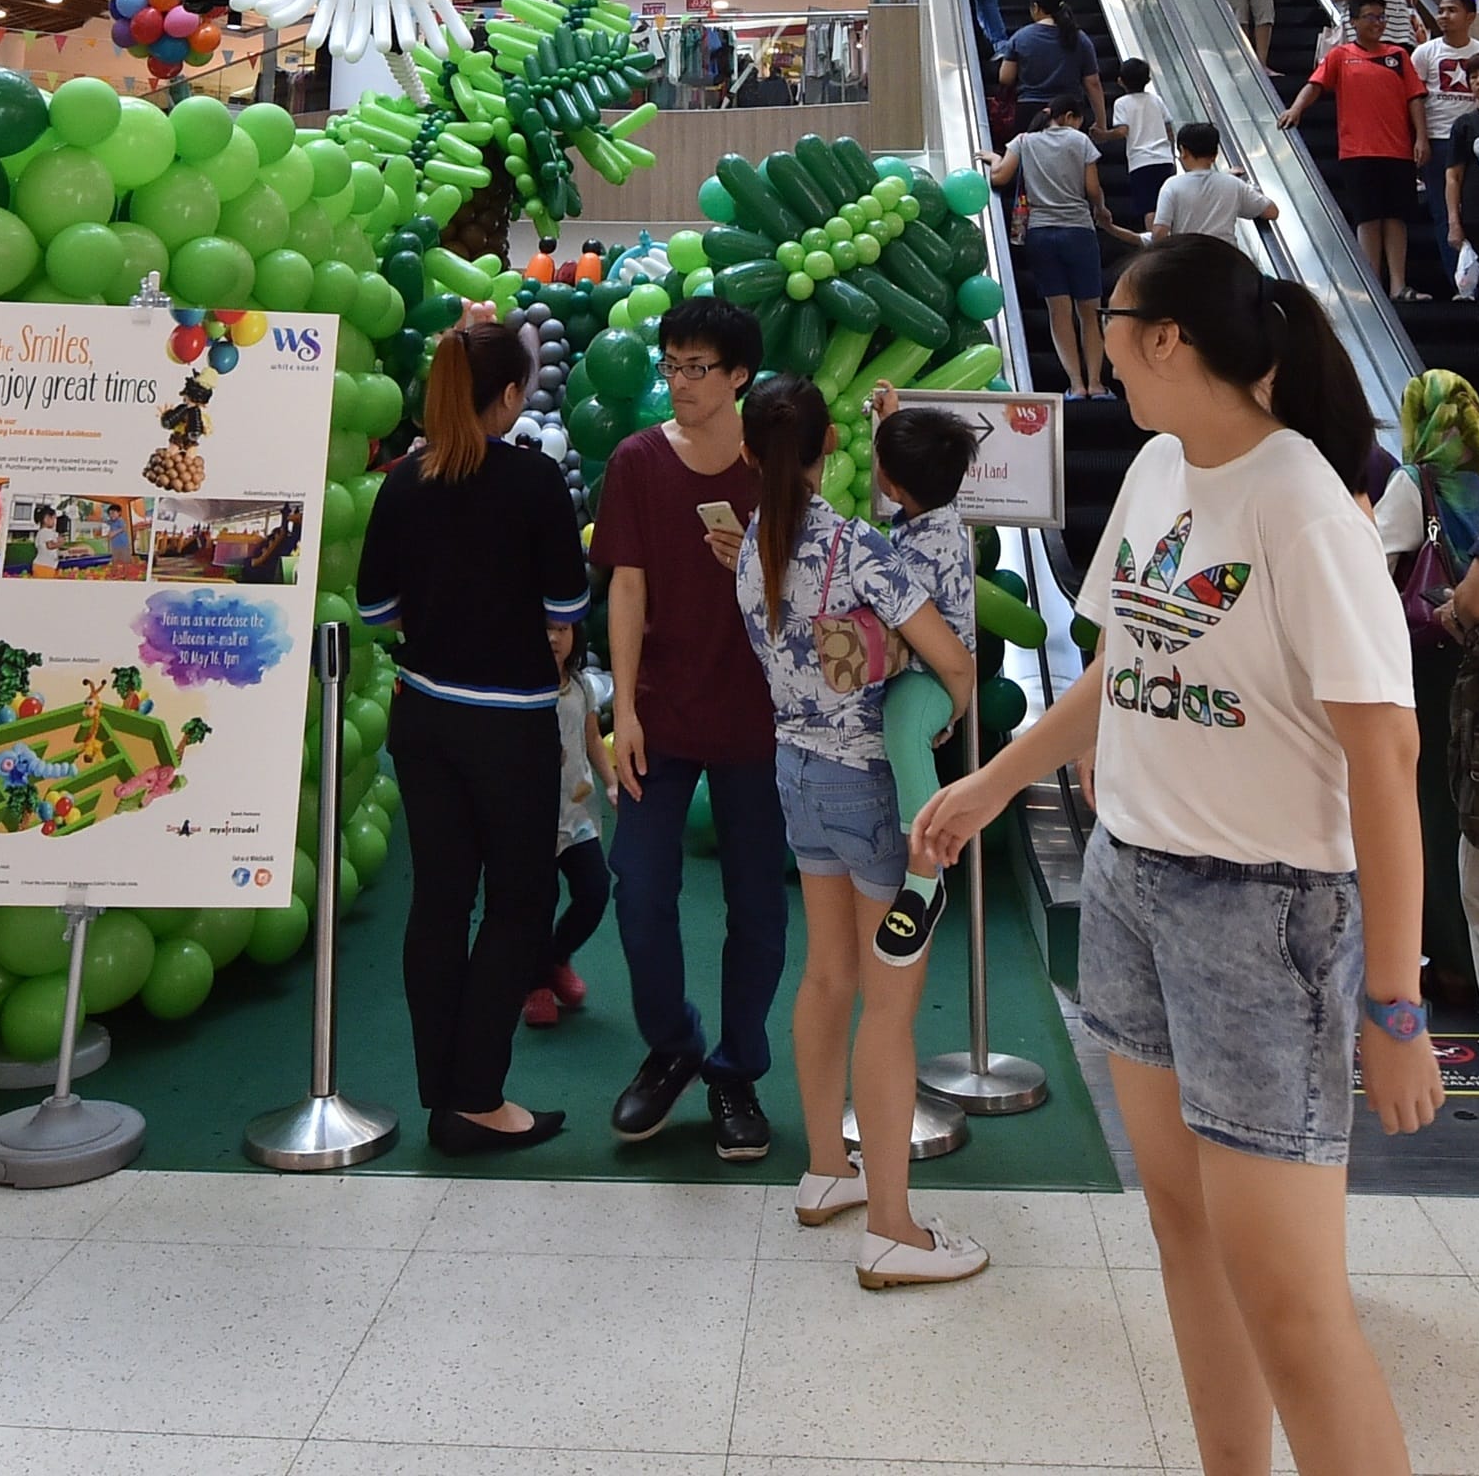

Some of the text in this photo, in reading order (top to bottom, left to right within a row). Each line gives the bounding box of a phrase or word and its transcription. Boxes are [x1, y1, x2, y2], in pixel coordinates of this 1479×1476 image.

[18, 324, 94, 370] Smiles,
[273, 327, 322, 362] WS
[41, 371, 98, 408] great
[104, 369, 157, 404] times
[1016, 406, 1037, 422] WS
[9, 428, 28, 436] Land
[985, 462, 1008, 479] Land
[162, 612, 264, 628] Join us as we release the
[172, 631, 249, 646] balloons in-mall on
[178, 651, 190, 664] 30
